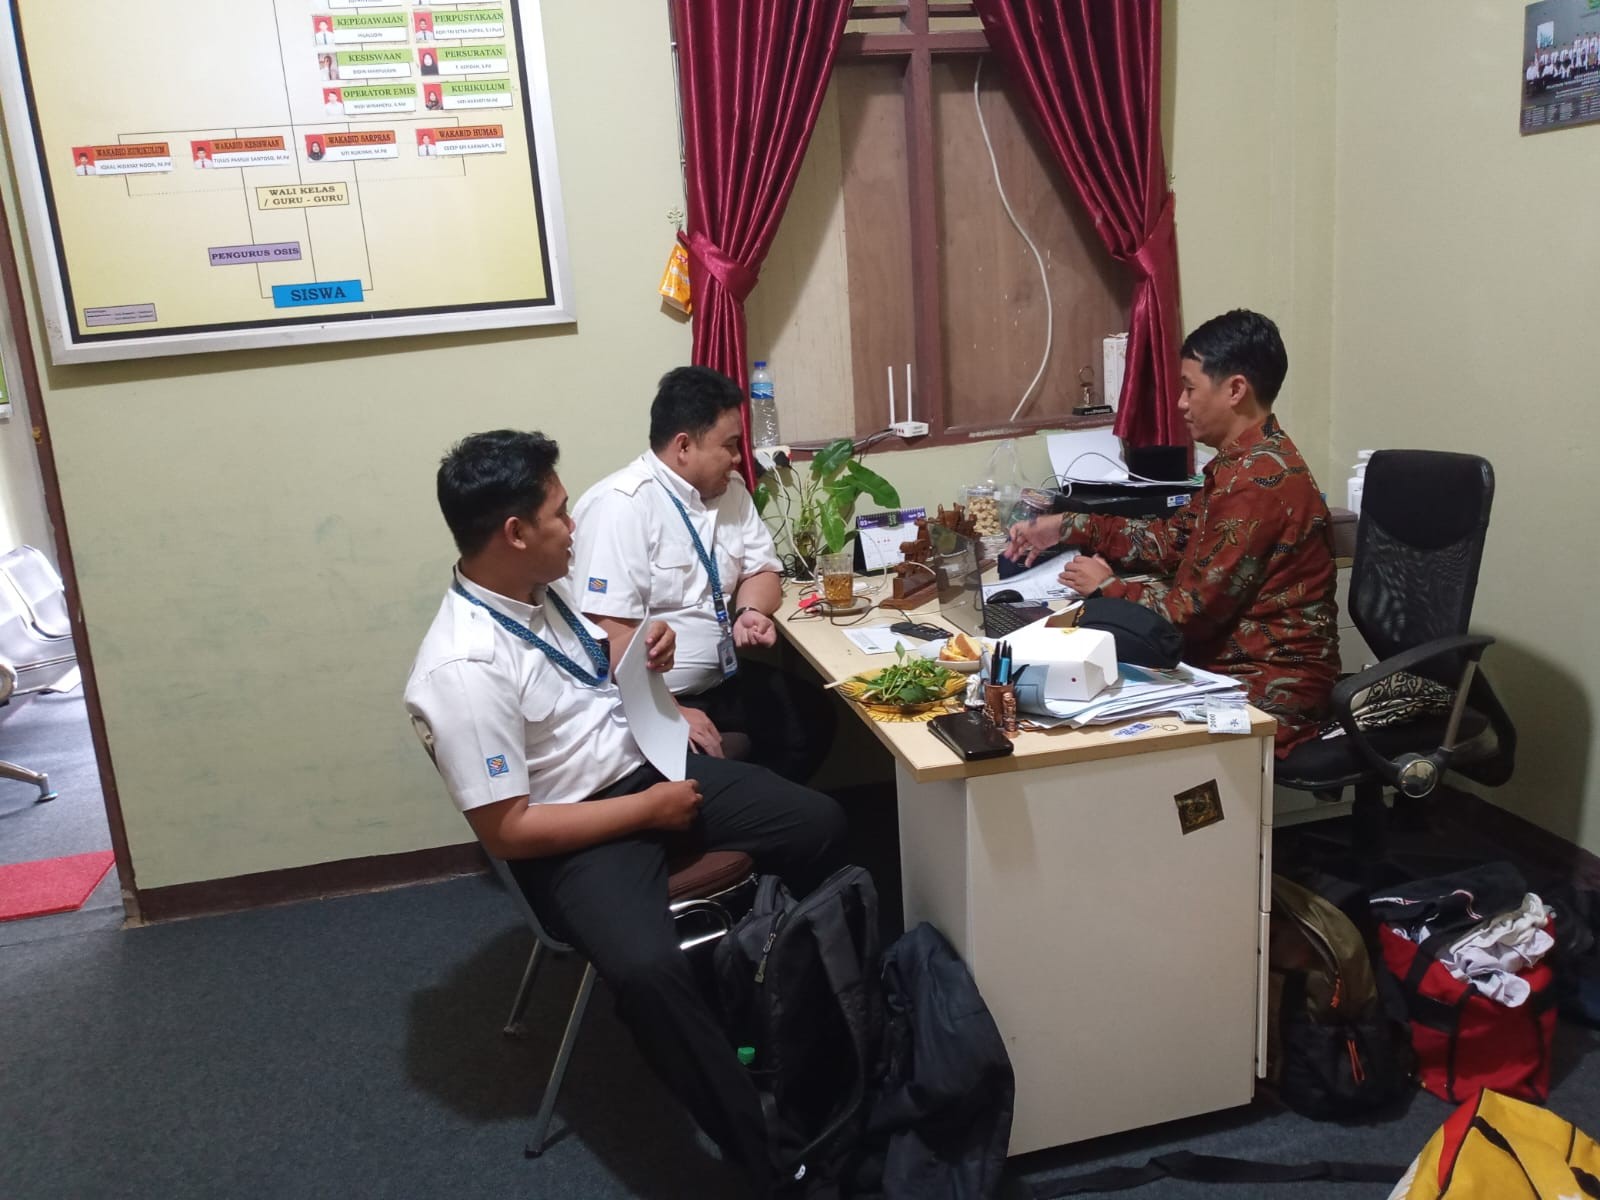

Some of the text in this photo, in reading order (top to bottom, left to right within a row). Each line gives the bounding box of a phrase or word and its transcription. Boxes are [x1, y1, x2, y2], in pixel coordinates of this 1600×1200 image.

[337, 16, 404, 26] KEPEGAWAIAN
[434, 13, 504, 23] PERPUSTAKAAN
[348, 53, 402, 62] KESISWAAN
[445, 48, 503, 58] PERSURATAN
[343, 87, 416, 98] OPERATOR EMIS
[451, 83, 505, 93] KURIKULUM
[438, 128, 498, 138] WAKABID HUMAS
[328, 134, 391, 144] WAKABID SARPRAS
[299, 185, 336, 194] KELAS
[272, 197, 303, 206] GURU
[313, 194, 344, 203] GURU
[211, 247, 300, 260] PENGURUS OSIS
[290, 286, 347, 302] SISWA
